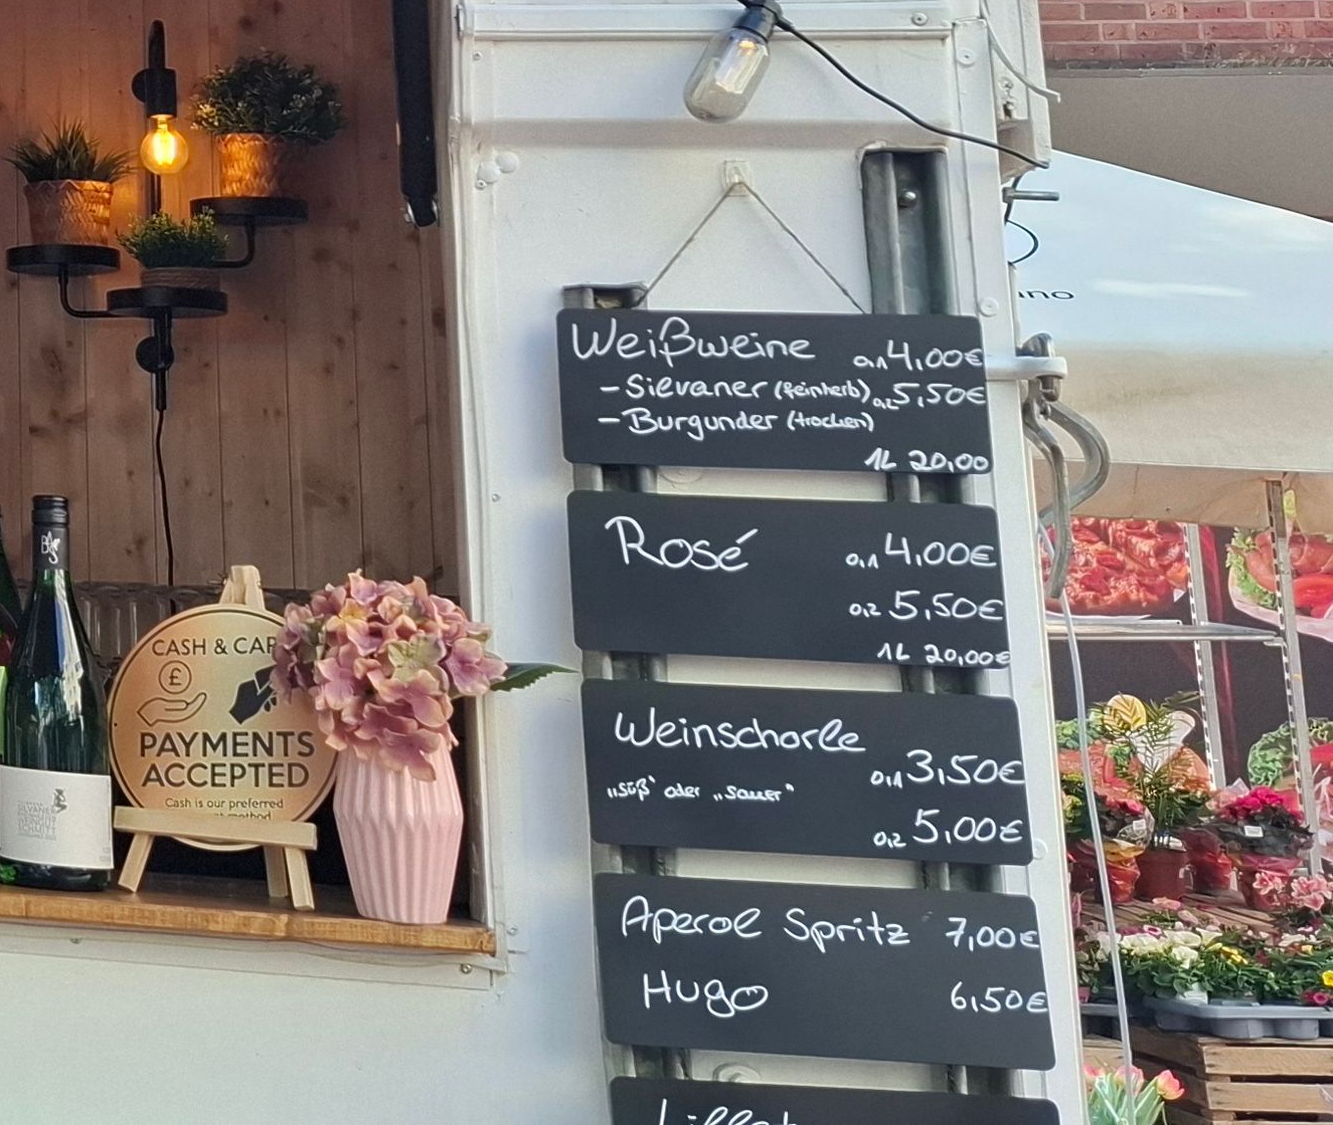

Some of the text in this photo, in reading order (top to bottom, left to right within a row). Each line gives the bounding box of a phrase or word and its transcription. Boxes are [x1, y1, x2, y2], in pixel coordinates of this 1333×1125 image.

[571, 316, 816, 368] Weißweine
[887, 339, 984, 371] 4,00€
[773, 378, 871, 404] (feinherb)
[892, 382, 986, 409] 5,50€
[787, 410, 875, 433] (trocken)
[907, 449, 989, 473] 20,00
[604, 515, 758, 571] Rosé
[884, 532, 997, 569] 4,00€
[889, 590, 1005, 622] 5,50€
[152, 637, 207, 657] CASH
[214, 636, 227, 656] &
[924, 643, 1011, 666] 20,00€
[140, 731, 315, 758] PAYMENTS
[614, 706, 866, 753] Weinschorle
[905, 749, 1026, 786] 3,50€
[141, 762, 310, 788] ACCEPTED
[165, 797, 284, 811] Cash is our preferred
[664, 783, 700, 799] oder
[911, 808, 1024, 845] 5,00€
[621, 894, 1041, 954] Aperol Spritz 7,00€
[643, 970, 1049, 1018] Hugo 6,50€
